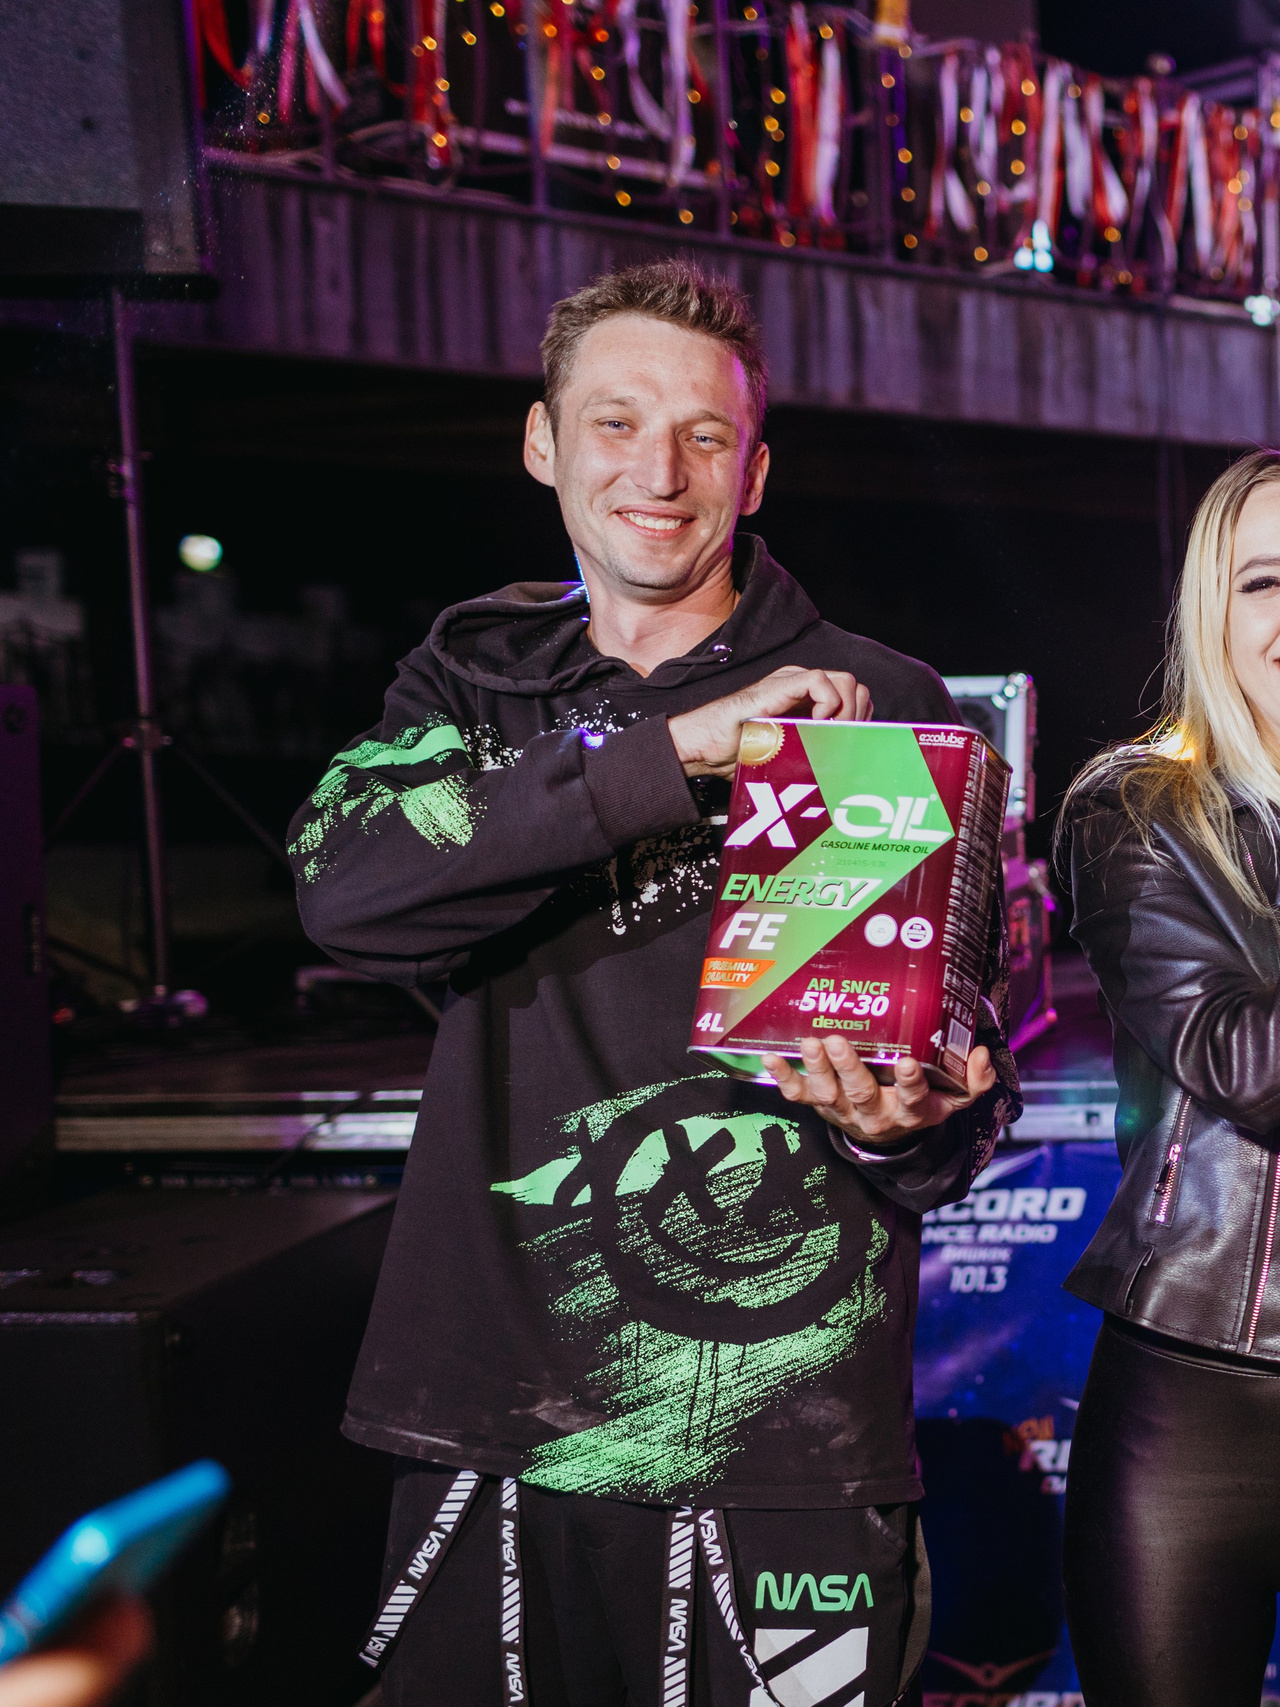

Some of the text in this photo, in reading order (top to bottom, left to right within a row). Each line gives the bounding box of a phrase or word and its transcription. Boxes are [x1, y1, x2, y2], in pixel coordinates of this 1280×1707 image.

[918, 731, 965, 746] exolube
[723, 781, 952, 848] X-OIL
[820, 840, 929, 854] GASOLINE MOTOR OIL
[720, 873, 869, 907] ENERGY
[718, 912, 788, 951] FE
[704, 970, 752, 983] QUALITY
[708, 960, 760, 973] PREMIUM
[806, 978, 891, 996] API SN/CF
[797, 990, 890, 1017] 5W-30
[696, 1012, 725, 1033] 4L
[811, 1015, 871, 1031] dexos1
[977, 1223, 1058, 1245] RADIO
[949, 1265, 1009, 1293] 101.3
[502, 1519, 518, 1572] NASA
[698, 1508, 724, 1566] NASA
[407, 1530, 446, 1581] NASA
[755, 1571, 875, 1612] NASA
[668, 1598, 689, 1652] NASA
[506, 1652, 525, 1702] NASA
